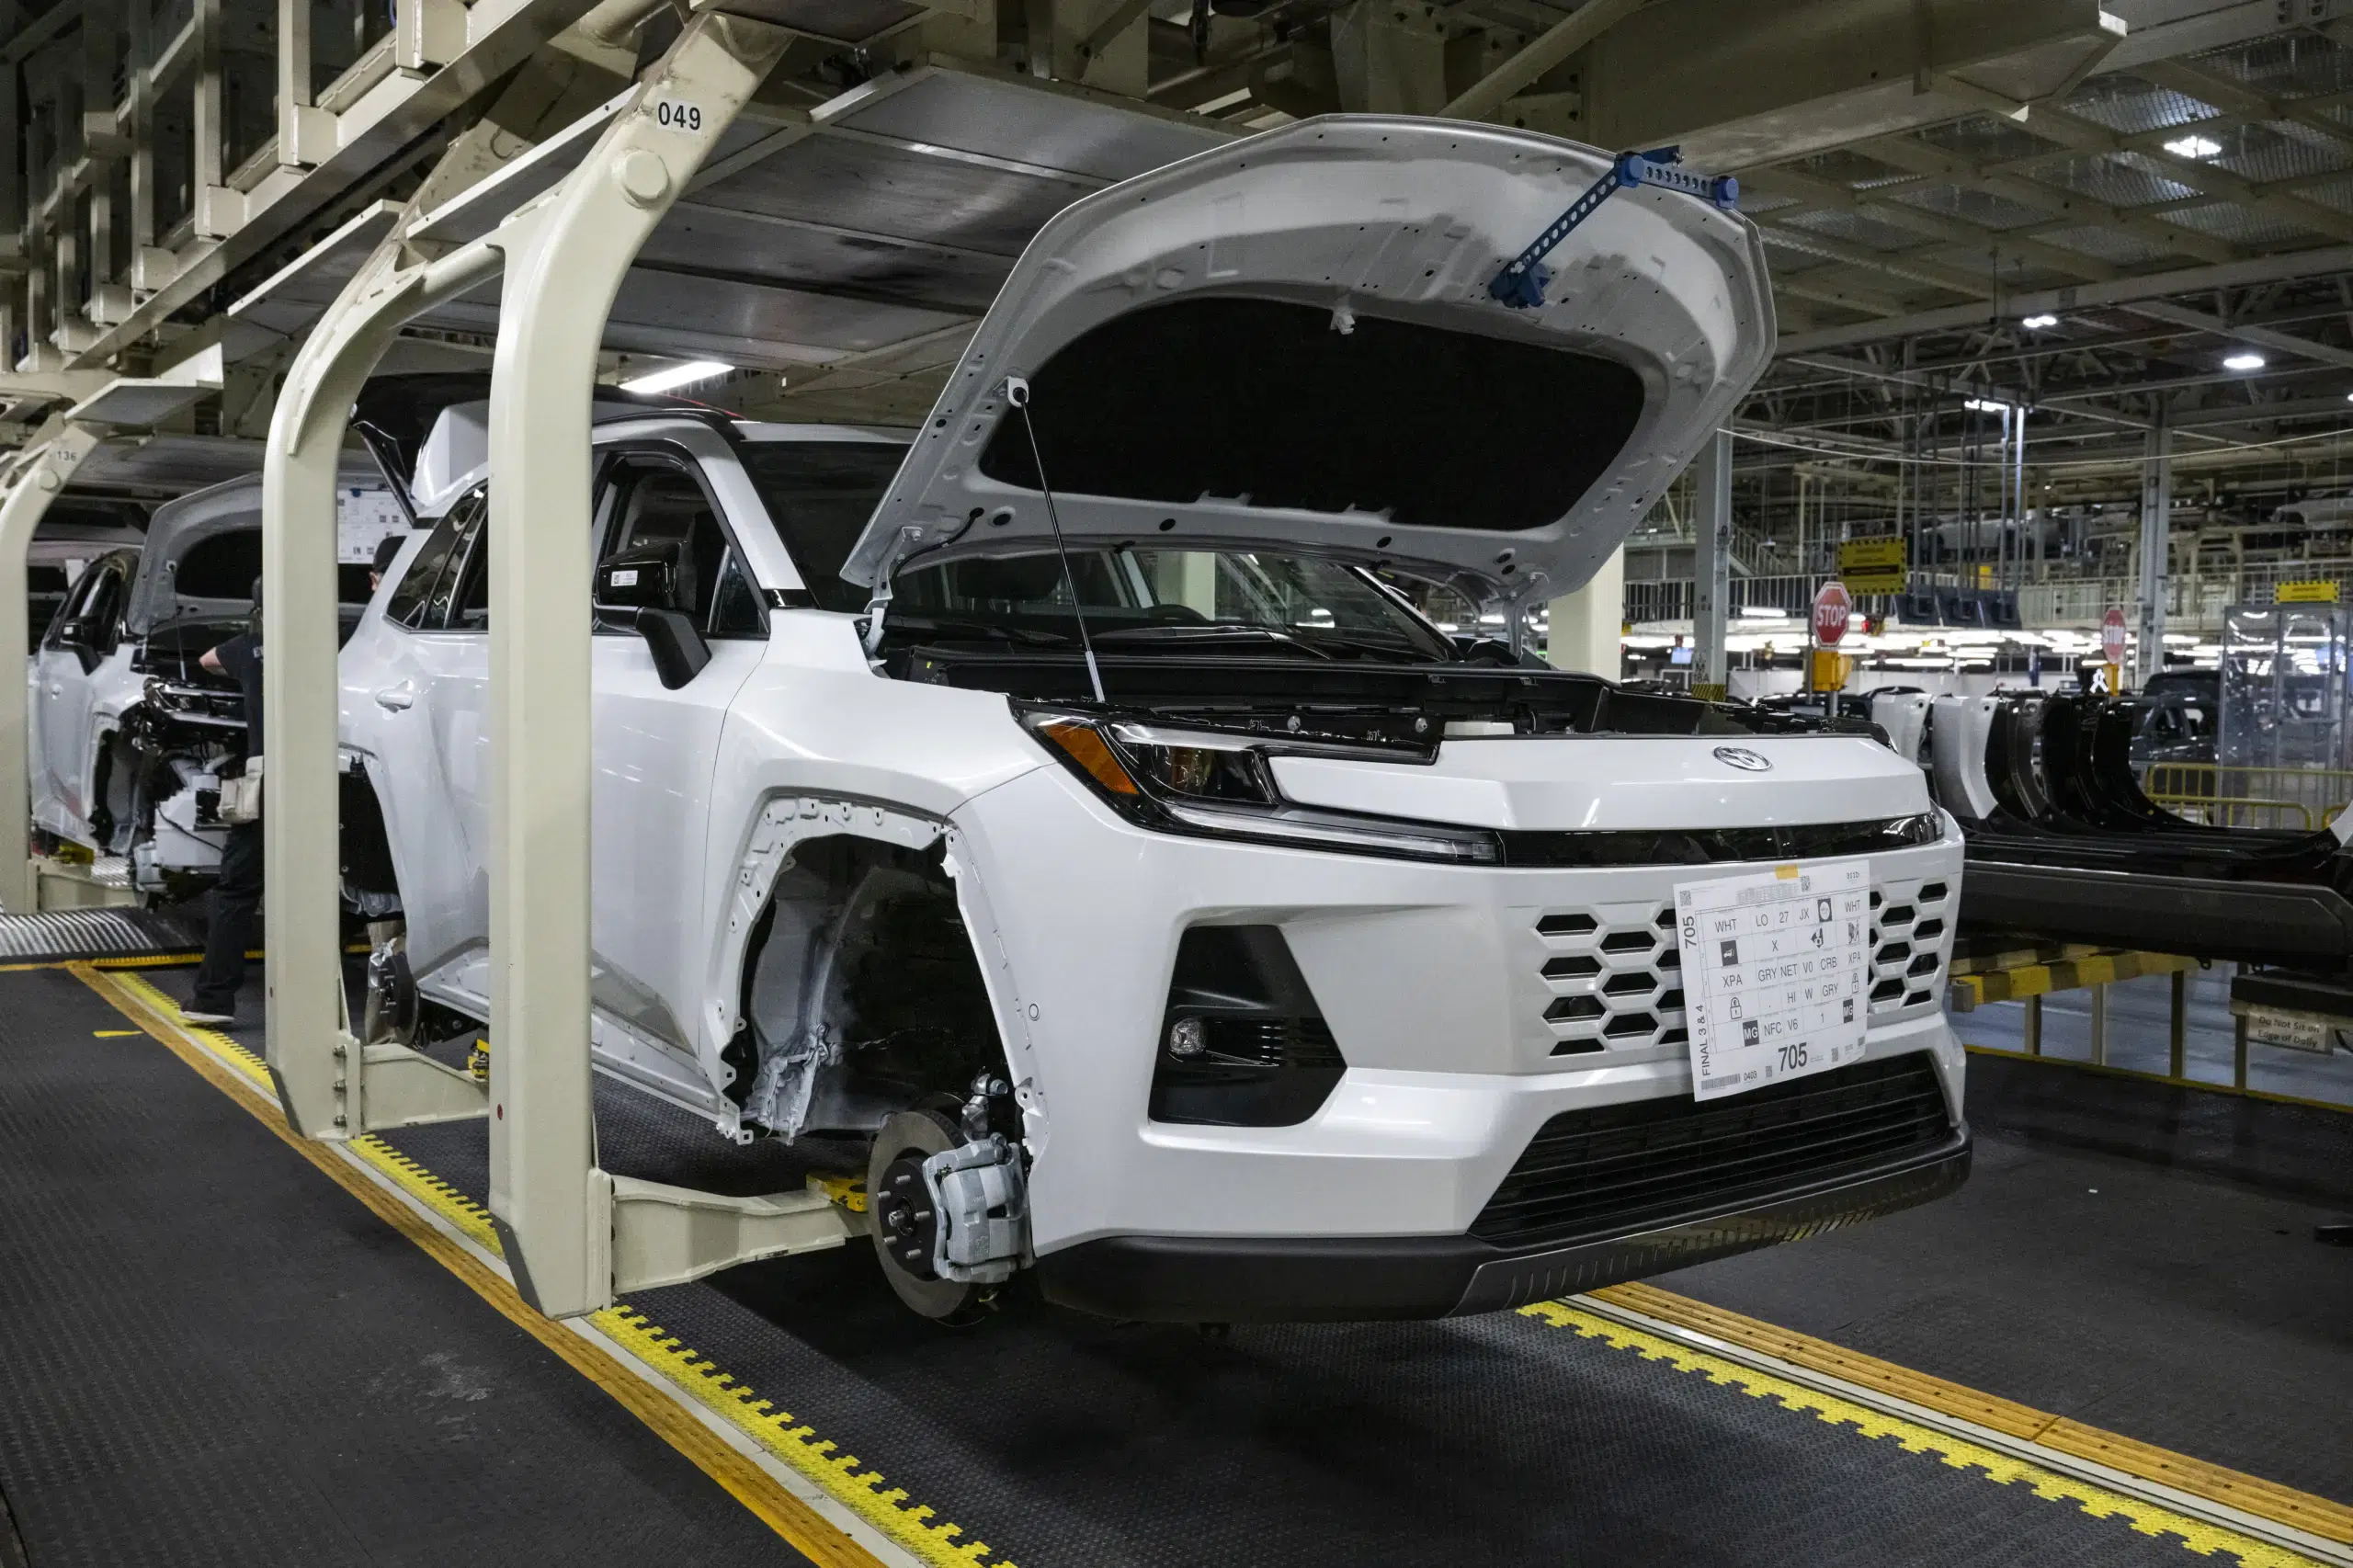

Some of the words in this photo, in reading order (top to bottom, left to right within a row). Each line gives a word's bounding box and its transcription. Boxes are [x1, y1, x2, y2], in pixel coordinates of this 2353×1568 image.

[658, 101, 701, 131] 049
[57, 450, 77, 461] 136
[1817, 604, 1847, 627] STOP
[1845, 899, 1861, 913] WHT
[1756, 914, 1768, 927] LO
[1779, 911, 1789, 924] 27
[1799, 907, 1810, 921] JX
[1682, 915, 1697, 949] 705
[1715, 918, 1737, 933] WHT
[1772, 939, 1779, 952] X
[1820, 956, 1837, 971] CRB
[1847, 951, 1861, 964] XPA
[1757, 968, 1778, 983] GRY
[1780, 963, 1798, 978] NET
[1722, 974, 1744, 988] XPA
[1804, 988, 1813, 1000] W
[1822, 983, 1839, 997] GRY
[1787, 991, 1796, 1004] HI
[1695, 1004, 1704, 1012] 4
[1843, 1005, 1853, 1016] MG
[1697, 1015, 1706, 1024] &
[1787, 1018, 1799, 1030] V6
[2258, 1016, 2272, 1026] Do
[2274, 1017, 2291, 1029] Not
[2293, 1021, 2306, 1030] Sit
[1698, 1028, 1707, 1036] 3
[1743, 1026, 1759, 1040] MG
[1763, 1021, 1783, 1037] NFC
[2257, 1028, 2280, 1040] Edge
[2281, 1033, 2292, 1042] of
[2293, 1035, 2318, 1048] Dolly
[1701, 1040, 1711, 1076] FINAL
[1778, 1041, 1808, 1073] 705
